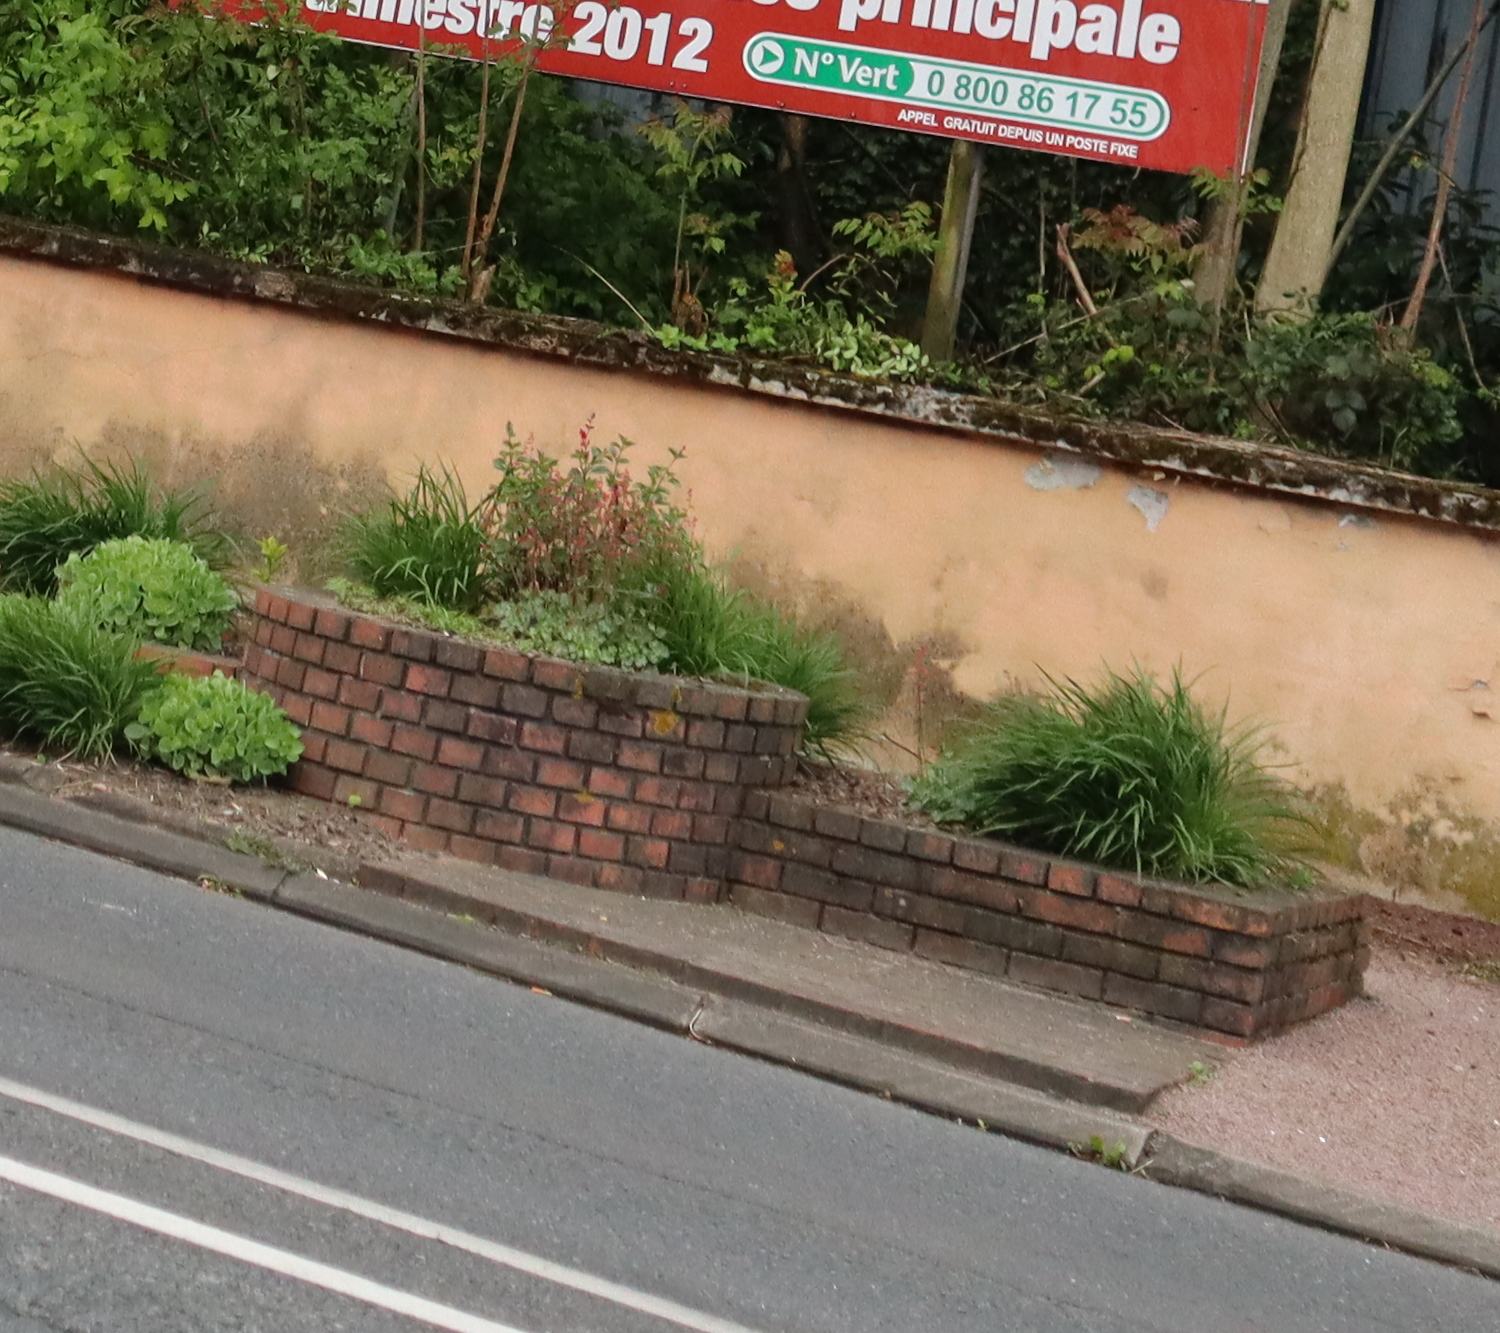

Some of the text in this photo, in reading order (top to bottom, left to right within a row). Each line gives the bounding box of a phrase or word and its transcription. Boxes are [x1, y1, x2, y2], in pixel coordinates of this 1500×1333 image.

[567, 0, 714, 73] 2012
[837, 54, 900, 91] Vert
[927, 69, 945, 96] 0
[953, 74, 1009, 106] 800
[1018, 83, 1055, 114] 86
[1066, 91, 1101, 120] 17
[1109, 98, 1149, 128] 55
[897, 108, 1138, 159] APPEL GRATUIT DEPUIS UN POSTE FIXE
